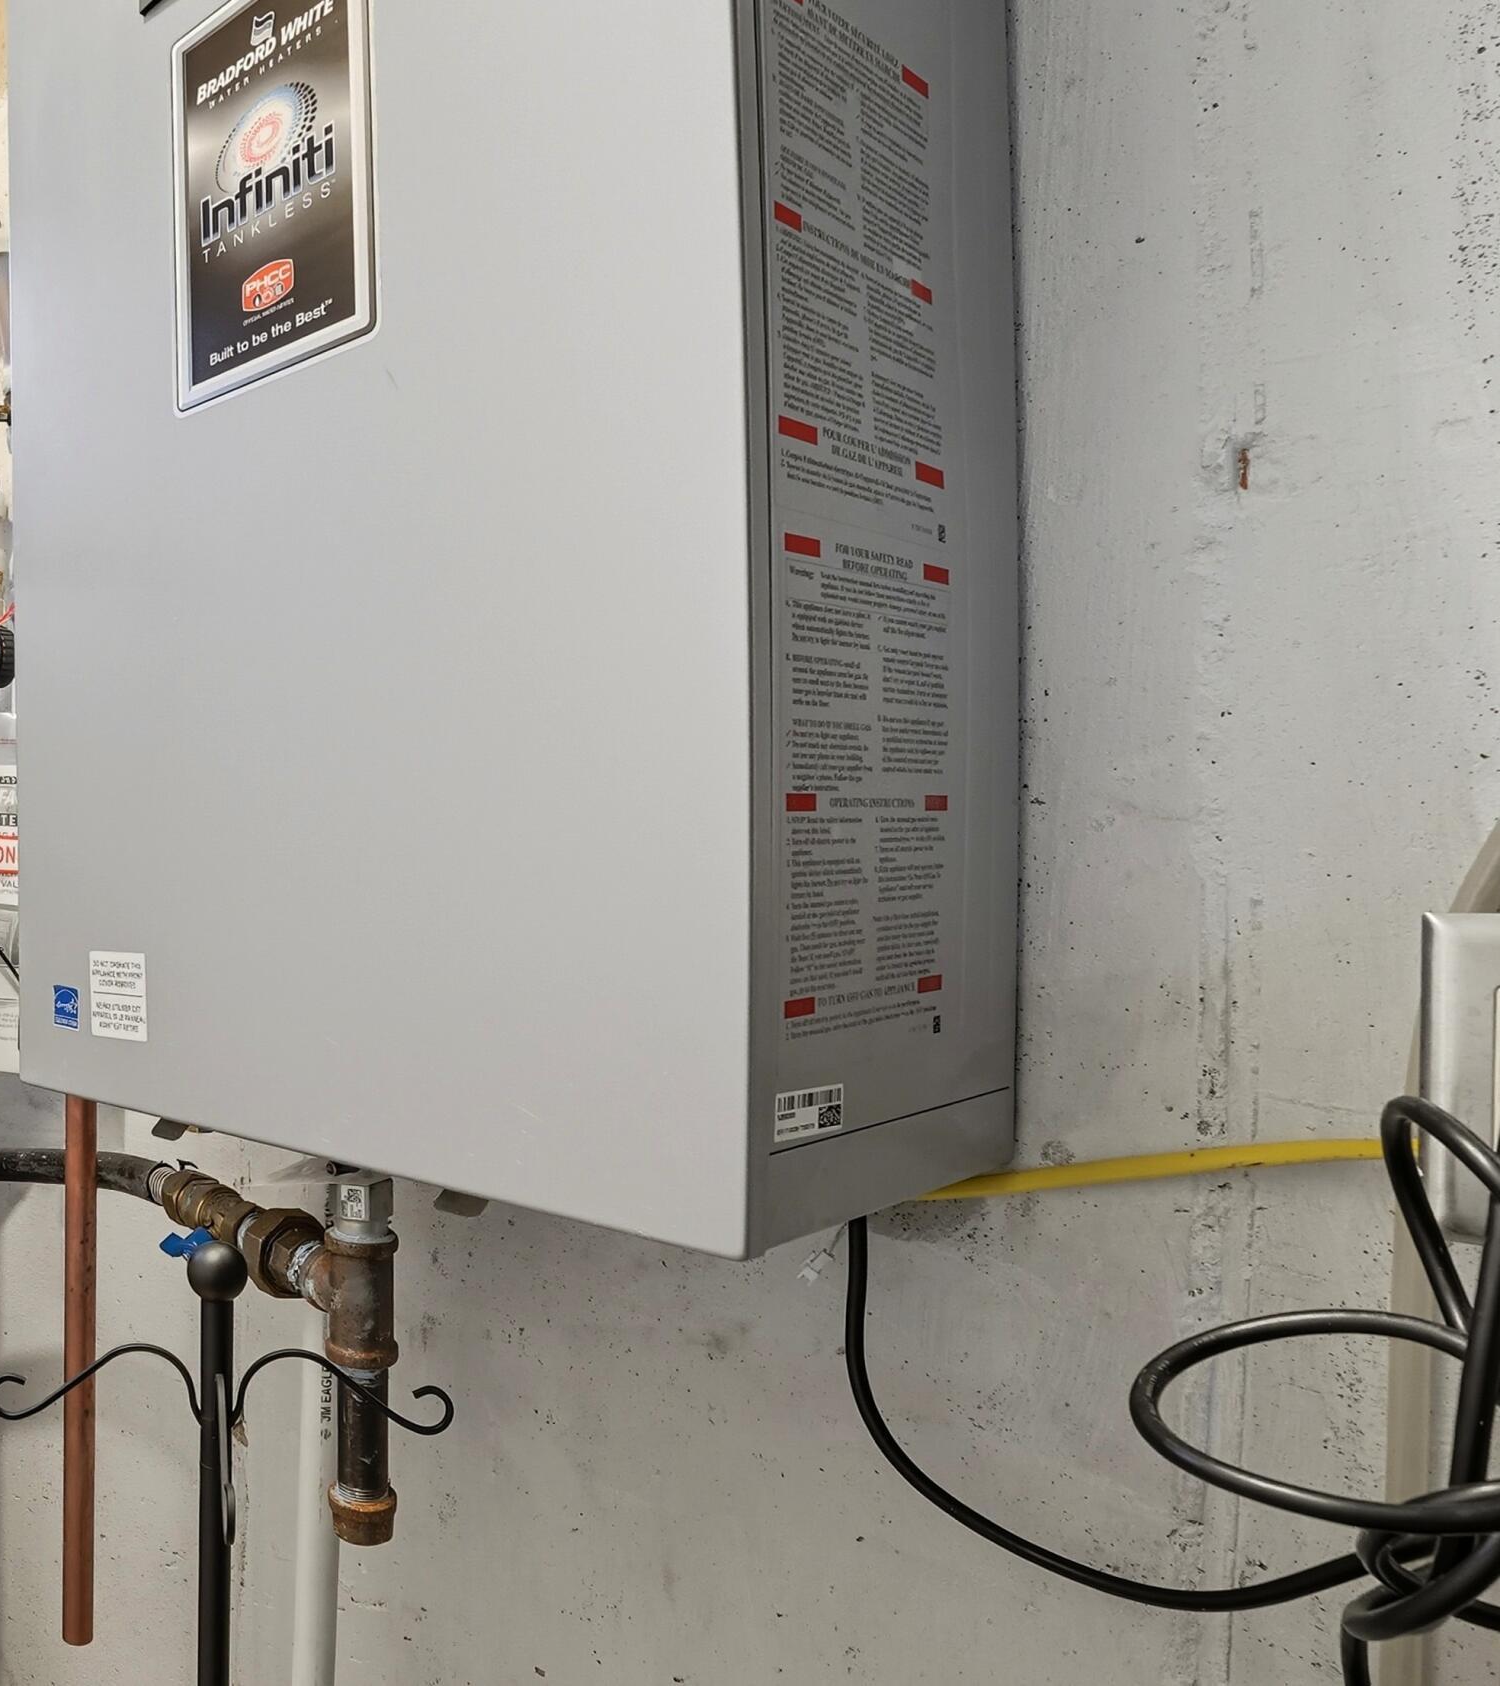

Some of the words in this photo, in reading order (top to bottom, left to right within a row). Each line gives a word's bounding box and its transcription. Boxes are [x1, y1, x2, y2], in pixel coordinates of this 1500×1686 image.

[196, 36, 277, 105] BRADFORD
[280, 0, 334, 45] WHITE
[208, 76, 250, 109] WATER
[259, 26, 322, 75] HEATERS
[200, 119, 336, 248] Infiniti
[202, 181, 332, 264] TANKLESS
[245, 263, 291, 297] PHCC
[209, 344, 235, 367] Built
[236, 339, 249, 355] to
[252, 329, 268, 348] be
[271, 320, 292, 339] the
